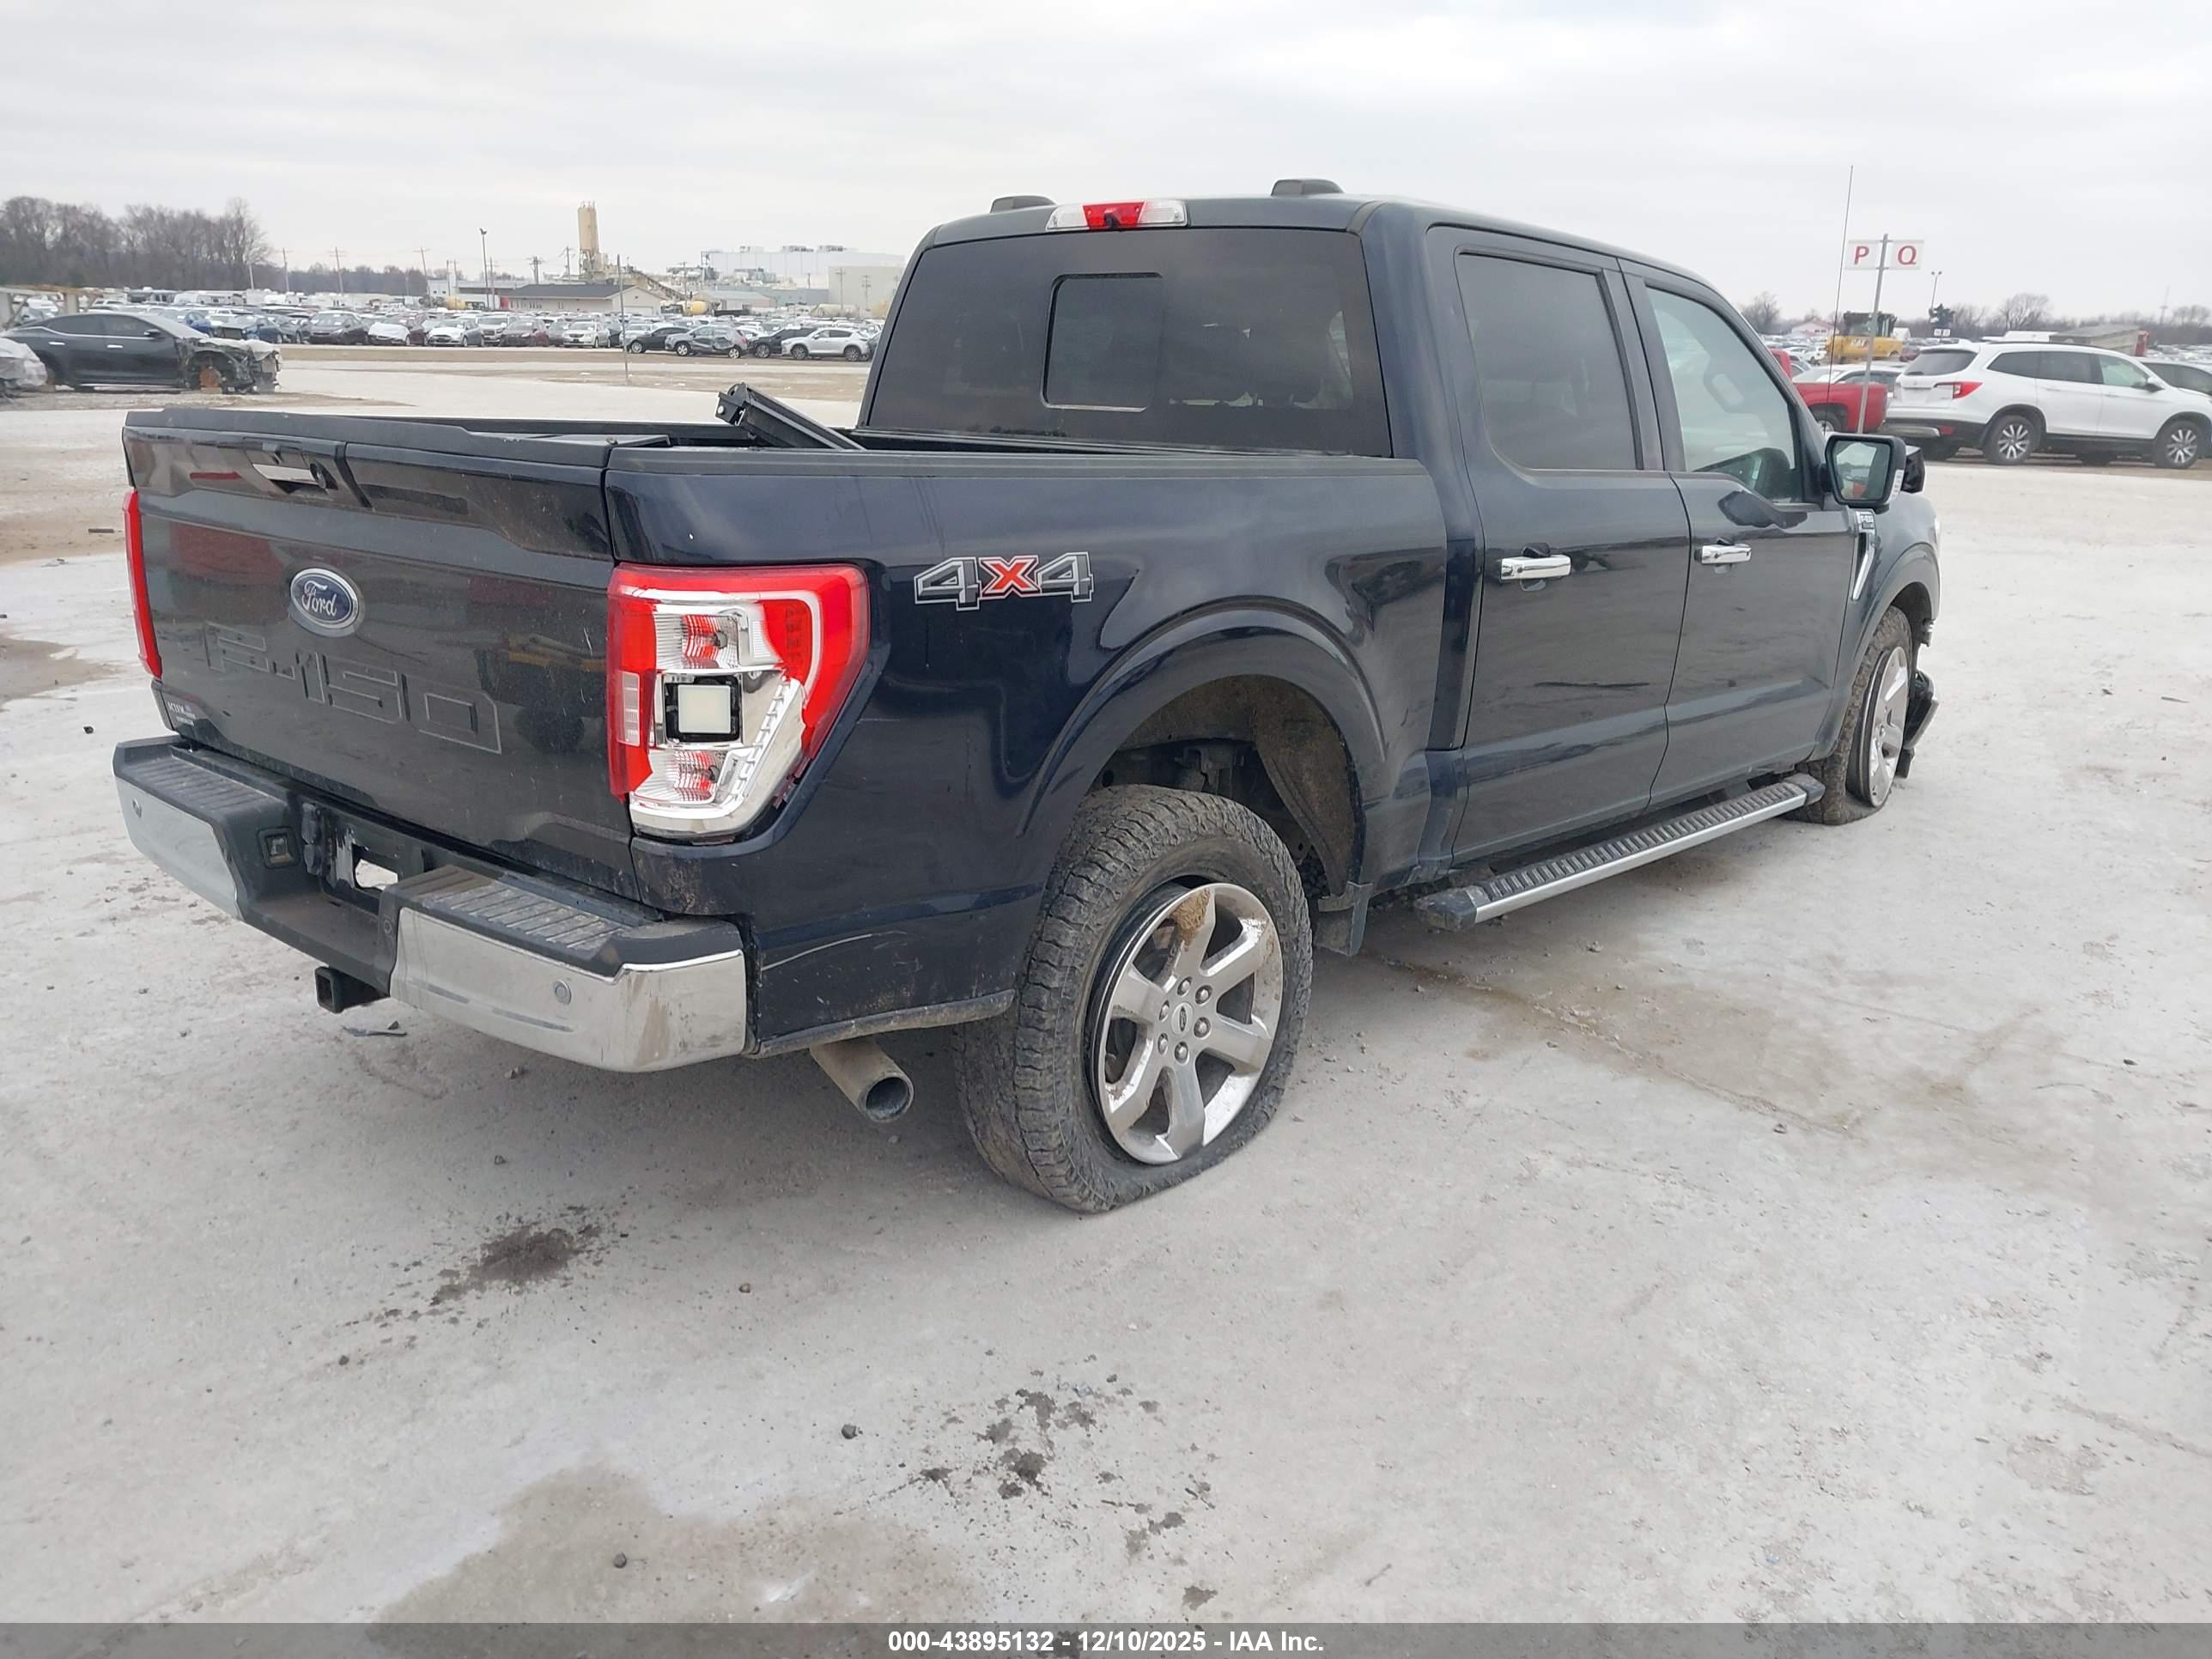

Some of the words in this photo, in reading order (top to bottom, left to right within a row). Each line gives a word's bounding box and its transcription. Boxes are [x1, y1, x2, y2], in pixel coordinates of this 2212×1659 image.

[1854, 246, 1869, 264] P
[1898, 246, 1917, 264] Q
[301, 580, 337, 617] Ford
[204, 620, 502, 755] F-150
